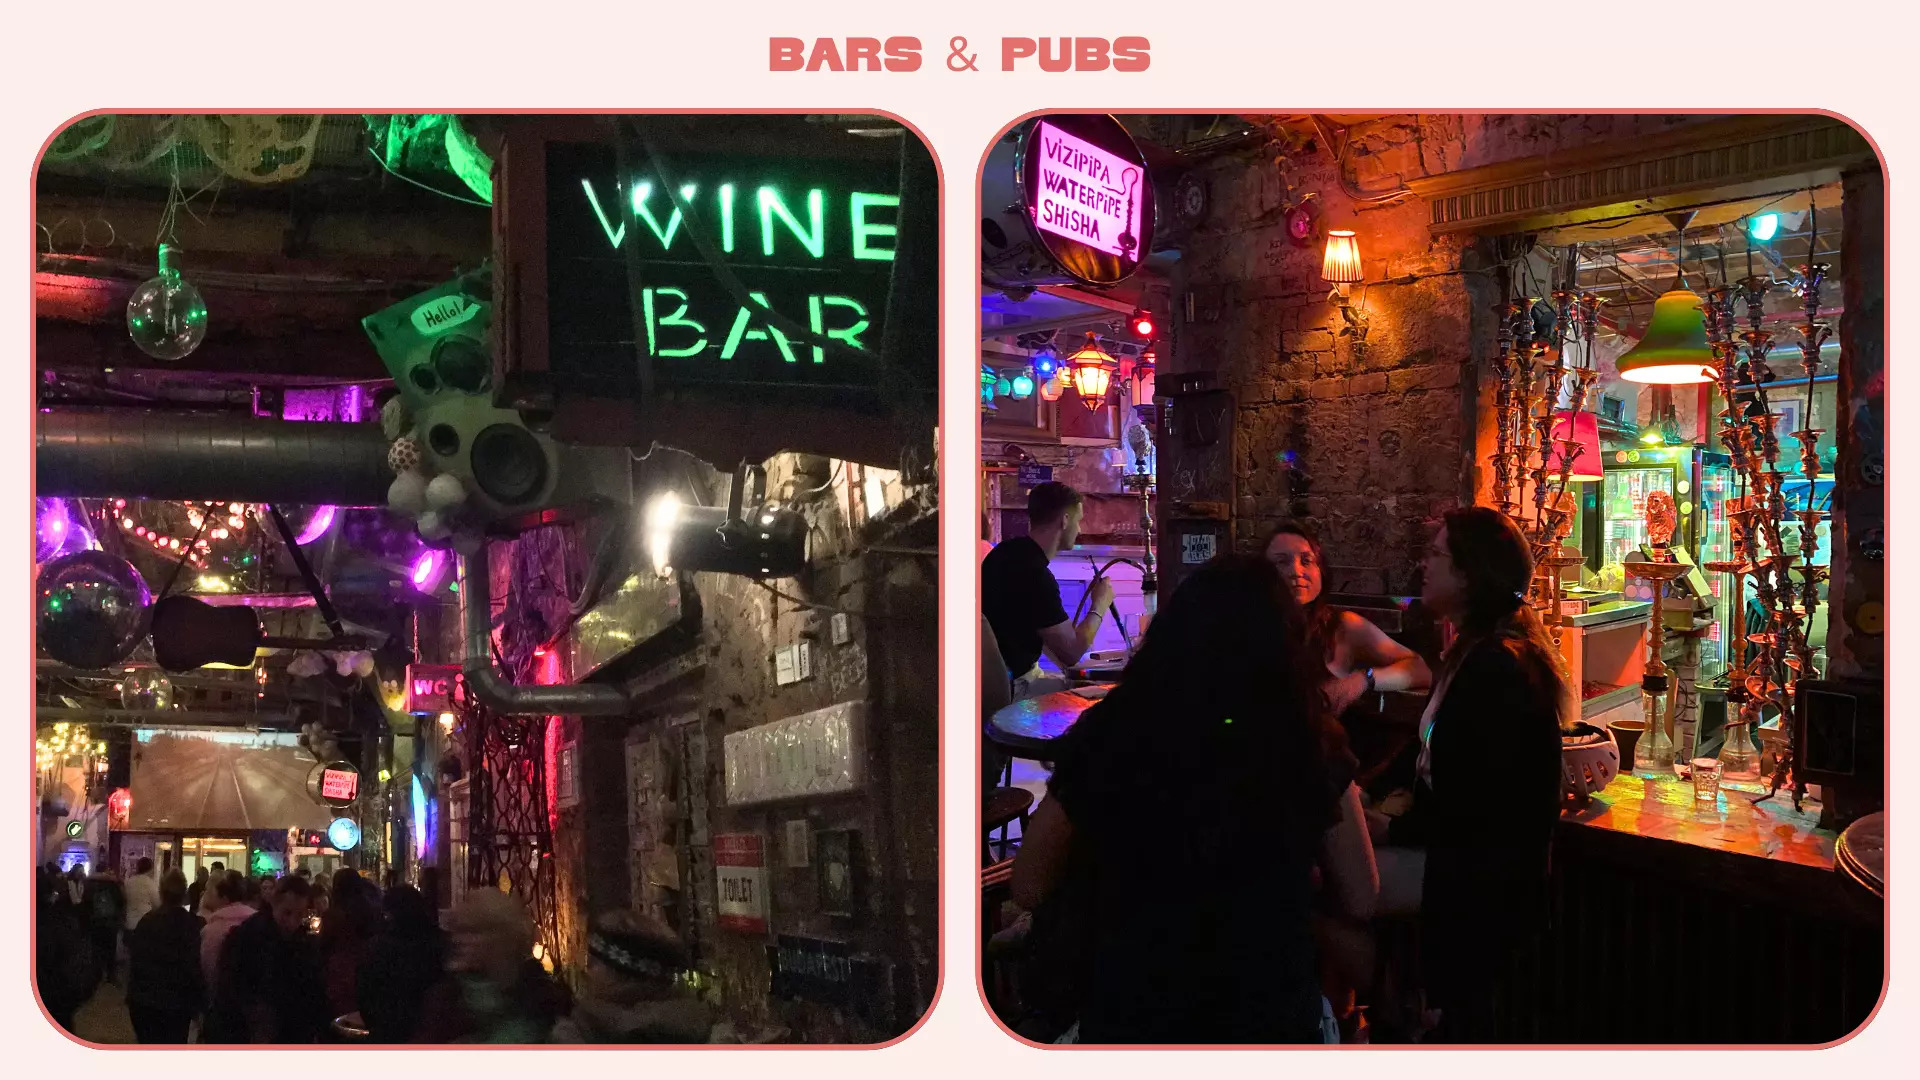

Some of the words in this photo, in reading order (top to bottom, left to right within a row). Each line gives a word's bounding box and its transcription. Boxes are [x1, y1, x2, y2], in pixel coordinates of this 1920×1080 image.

[581, 177, 900, 260] WINE
[423, 300, 464, 328] Hello!
[642, 287, 870, 364] BAR
[413, 679, 448, 696] WC
[721, 876, 753, 903] TOILET
